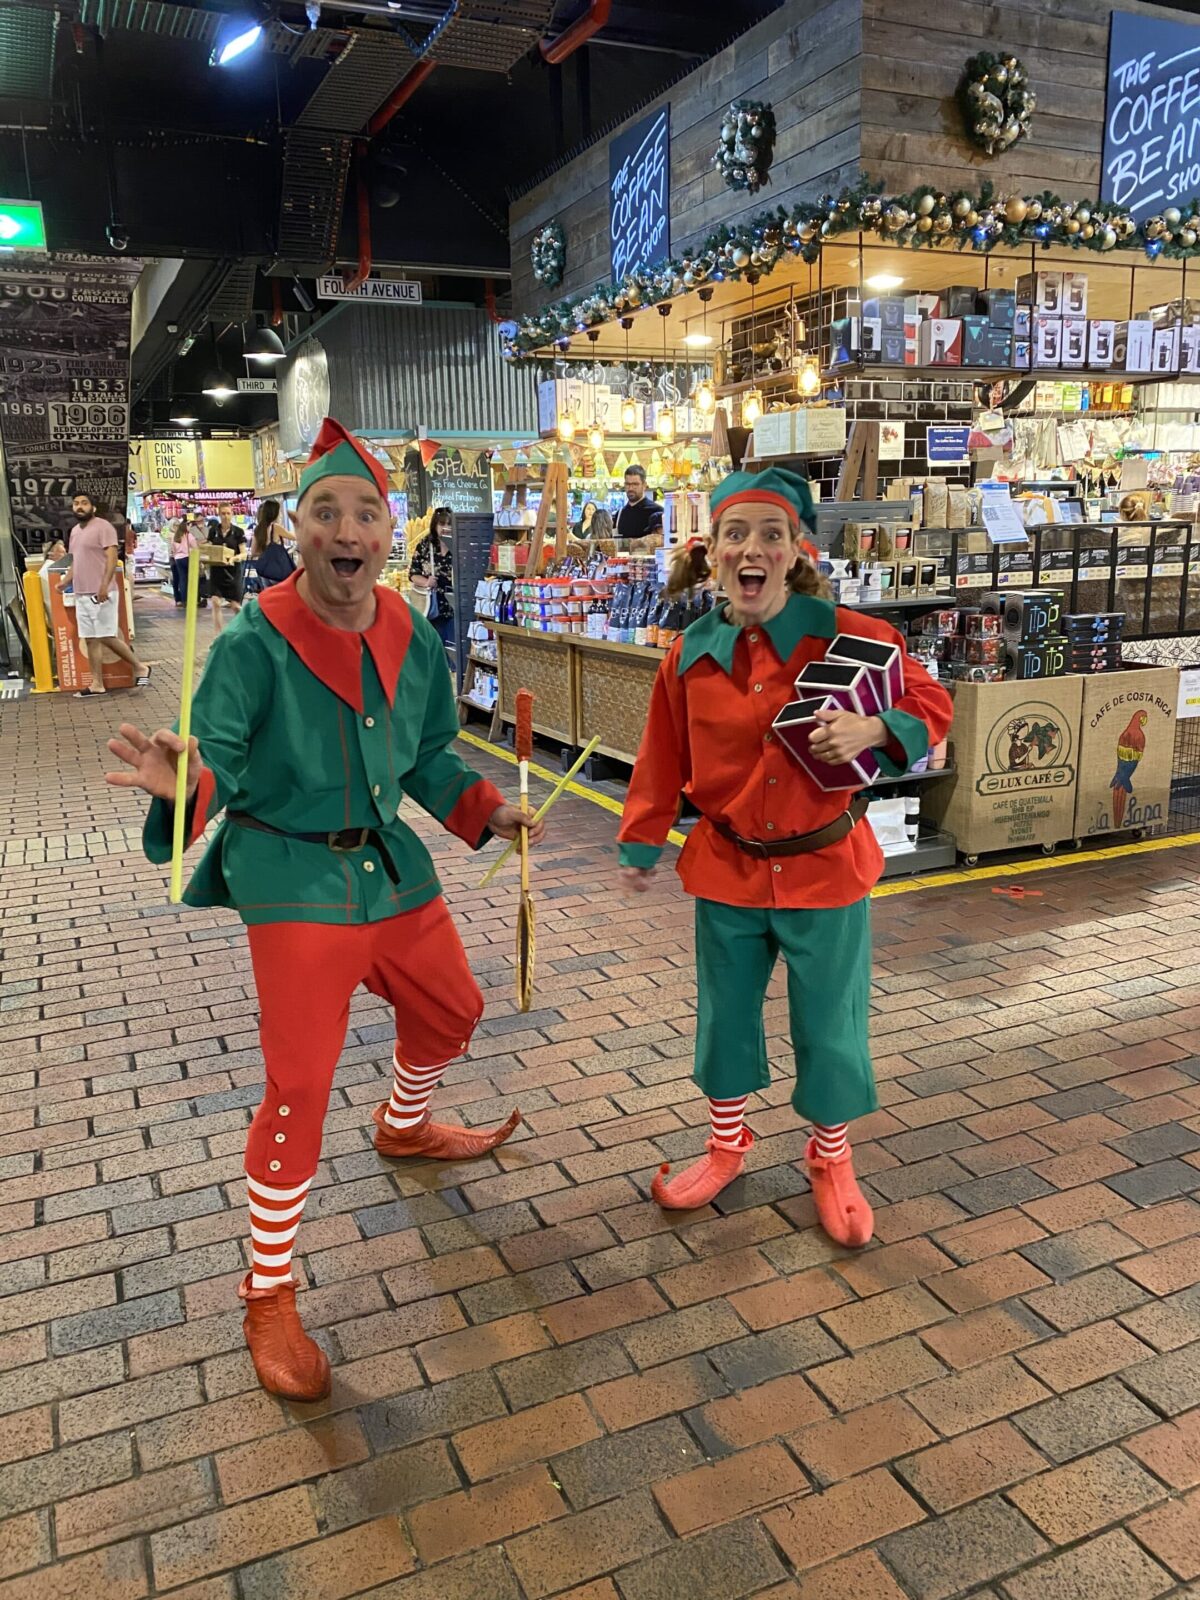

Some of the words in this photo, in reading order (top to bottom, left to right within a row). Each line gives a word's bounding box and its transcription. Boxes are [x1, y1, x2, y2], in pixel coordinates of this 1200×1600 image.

[1113, 51, 1156, 93] THE
[611, 155, 630, 199] THE
[611, 125, 666, 240] COFFEE
[612, 166, 665, 283] BEAN
[641, 215, 666, 263] SHOP
[72, 295, 129, 304] COMPLETED
[371, 283, 415, 299] AVENUE
[0, 359, 62, 377] 1925
[66, 368, 90, 376] TWO
[93, 369, 127, 377] SHOPS
[72, 378, 125, 391] 1933
[242, 381, 265, 390] THIRD
[2, 402, 46, 416] 1965
[51, 404, 126, 426] 1966
[53, 426, 125, 434] REDEVELOPMENT
[53, 433, 125, 441] OPENED
[24, 442, 57, 453] CORNER
[154, 443, 183, 454] CON'S
[155, 455, 176, 467] FINE
[435, 457, 488, 479] SPECAL
[157, 467, 181, 479] FOOD
[10, 478, 73, 496] 1977
[17, 528, 72, 545] 199
[58, 626, 68, 652] WASTE
[61, 654, 71, 687] GENERAL
[1090, 702, 1112, 728] CAFE
[1112, 694, 1124, 706] DE
[1126, 691, 1153, 702] COSTA
[1154, 697, 1173, 718] RICA
[1000, 776, 1022, 789] LUX
[1023, 771, 1052, 785] CAFÉ
[1010, 799, 1017, 808] DE
[1018, 795, 1054, 807] GUATEMALA
[1123, 796, 1163, 828] Lapa
